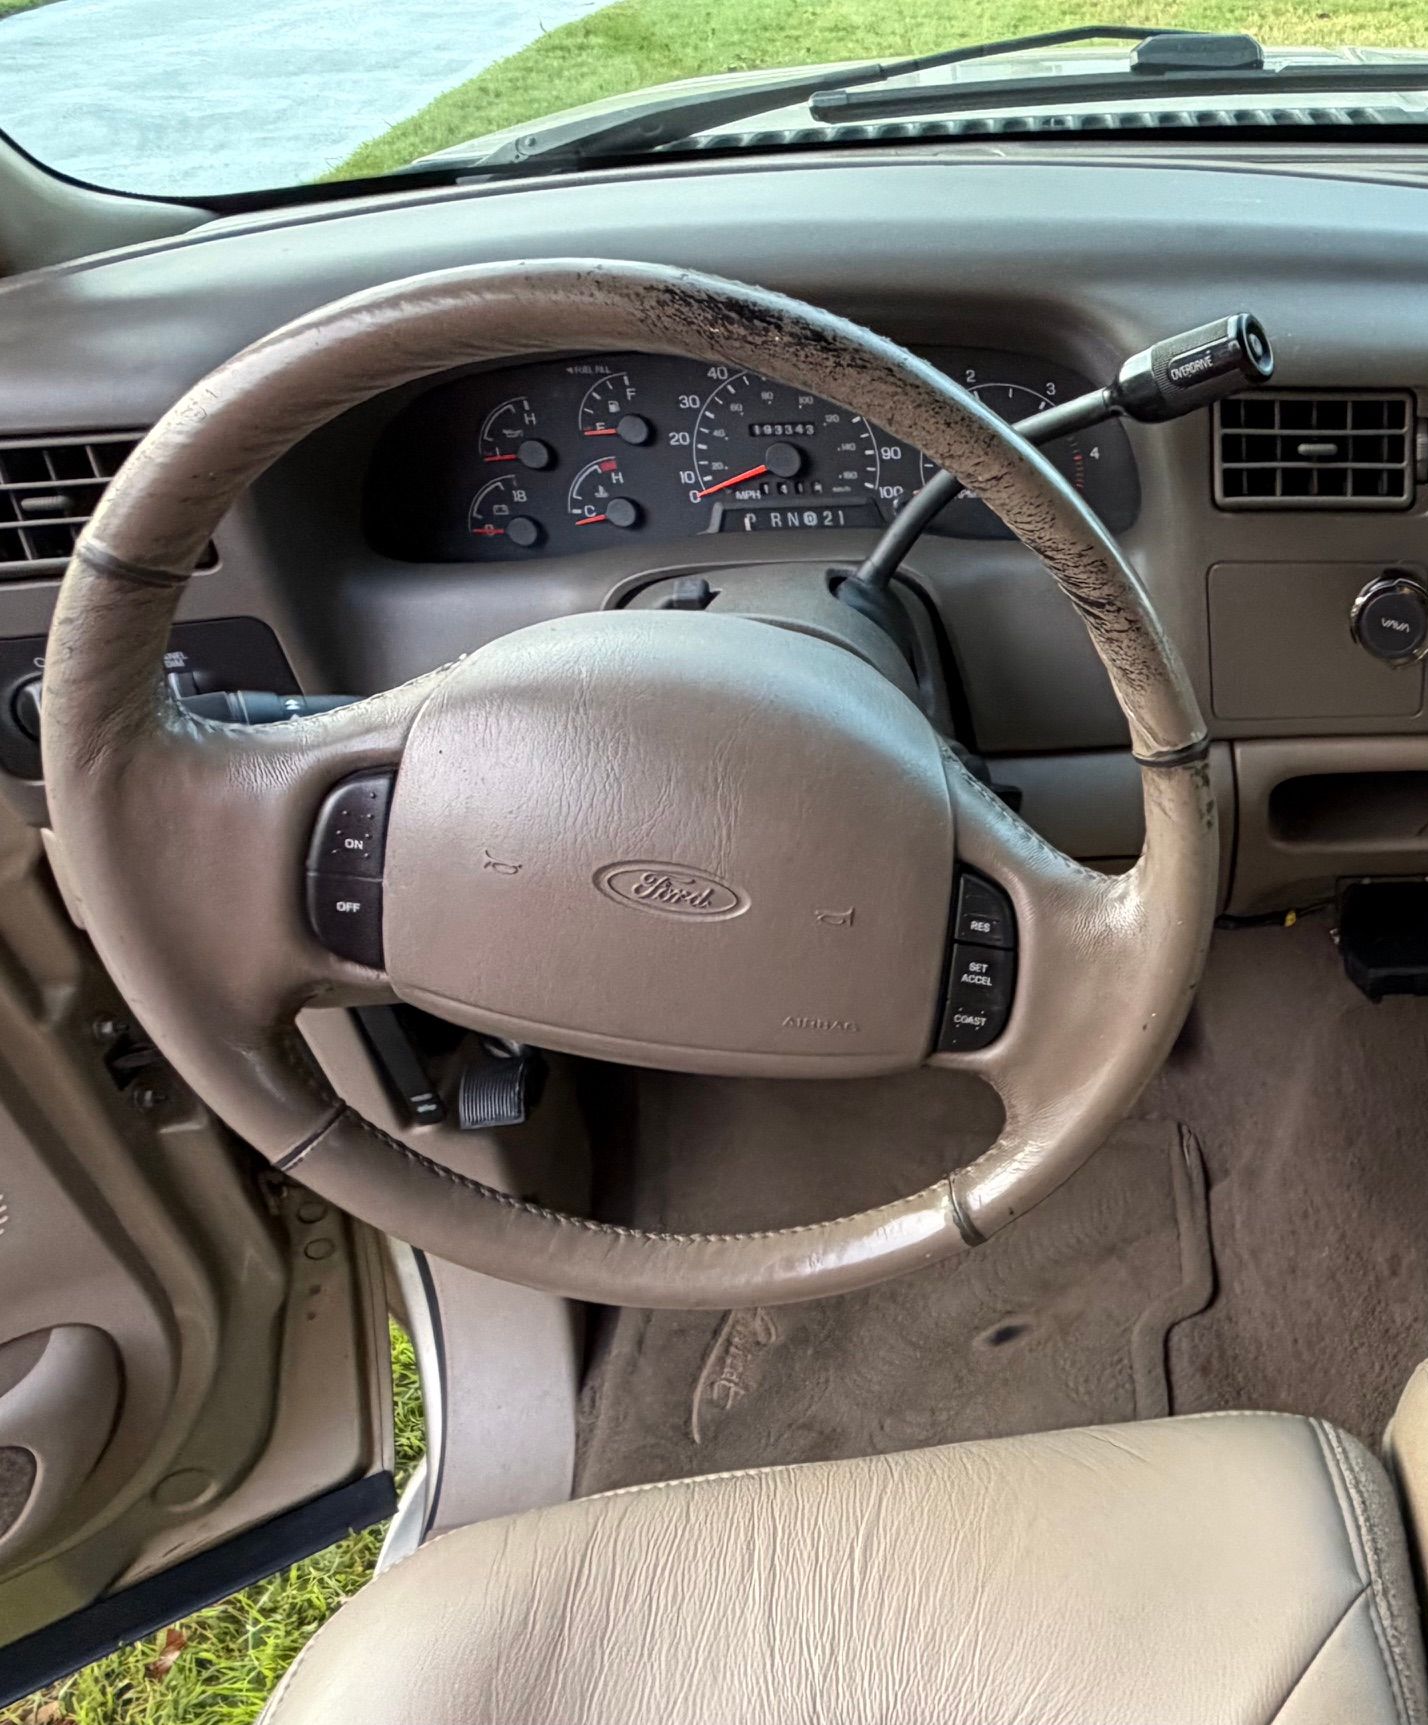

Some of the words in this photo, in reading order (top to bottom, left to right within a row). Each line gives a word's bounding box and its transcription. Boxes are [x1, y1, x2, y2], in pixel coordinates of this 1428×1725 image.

[707, 366, 728, 380] 40
[1171, 355, 1213, 381] OVERDRIVE
[965, 369, 976, 383] 2
[626, 388, 636, 400] F
[1046, 382, 1057, 396] 3
[679, 394, 700, 409] 30
[523, 413, 536, 425] H
[668, 432, 690, 446] 20
[880, 447, 902, 460] 90
[1090, 446, 1100, 460] 4
[611, 472, 624, 484] H
[680, 471, 696, 484] 10
[512, 490, 528, 502] 18
[689, 490, 702, 503] 0
[735, 490, 761, 500] MPH
[879, 486, 904, 499] 100
[584, 505, 596, 517] C
[770, 512, 782, 528] R
[787, 511, 800, 527] N
[344, 838, 363, 850] ON
[632, 871, 715, 909] Ford
[336, 901, 361, 912] OFF
[970, 920, 991, 933] RES
[969, 962, 989, 973] SET
[961, 973, 993, 986] ACCEL
[953, 1014, 987, 1026] COAST
